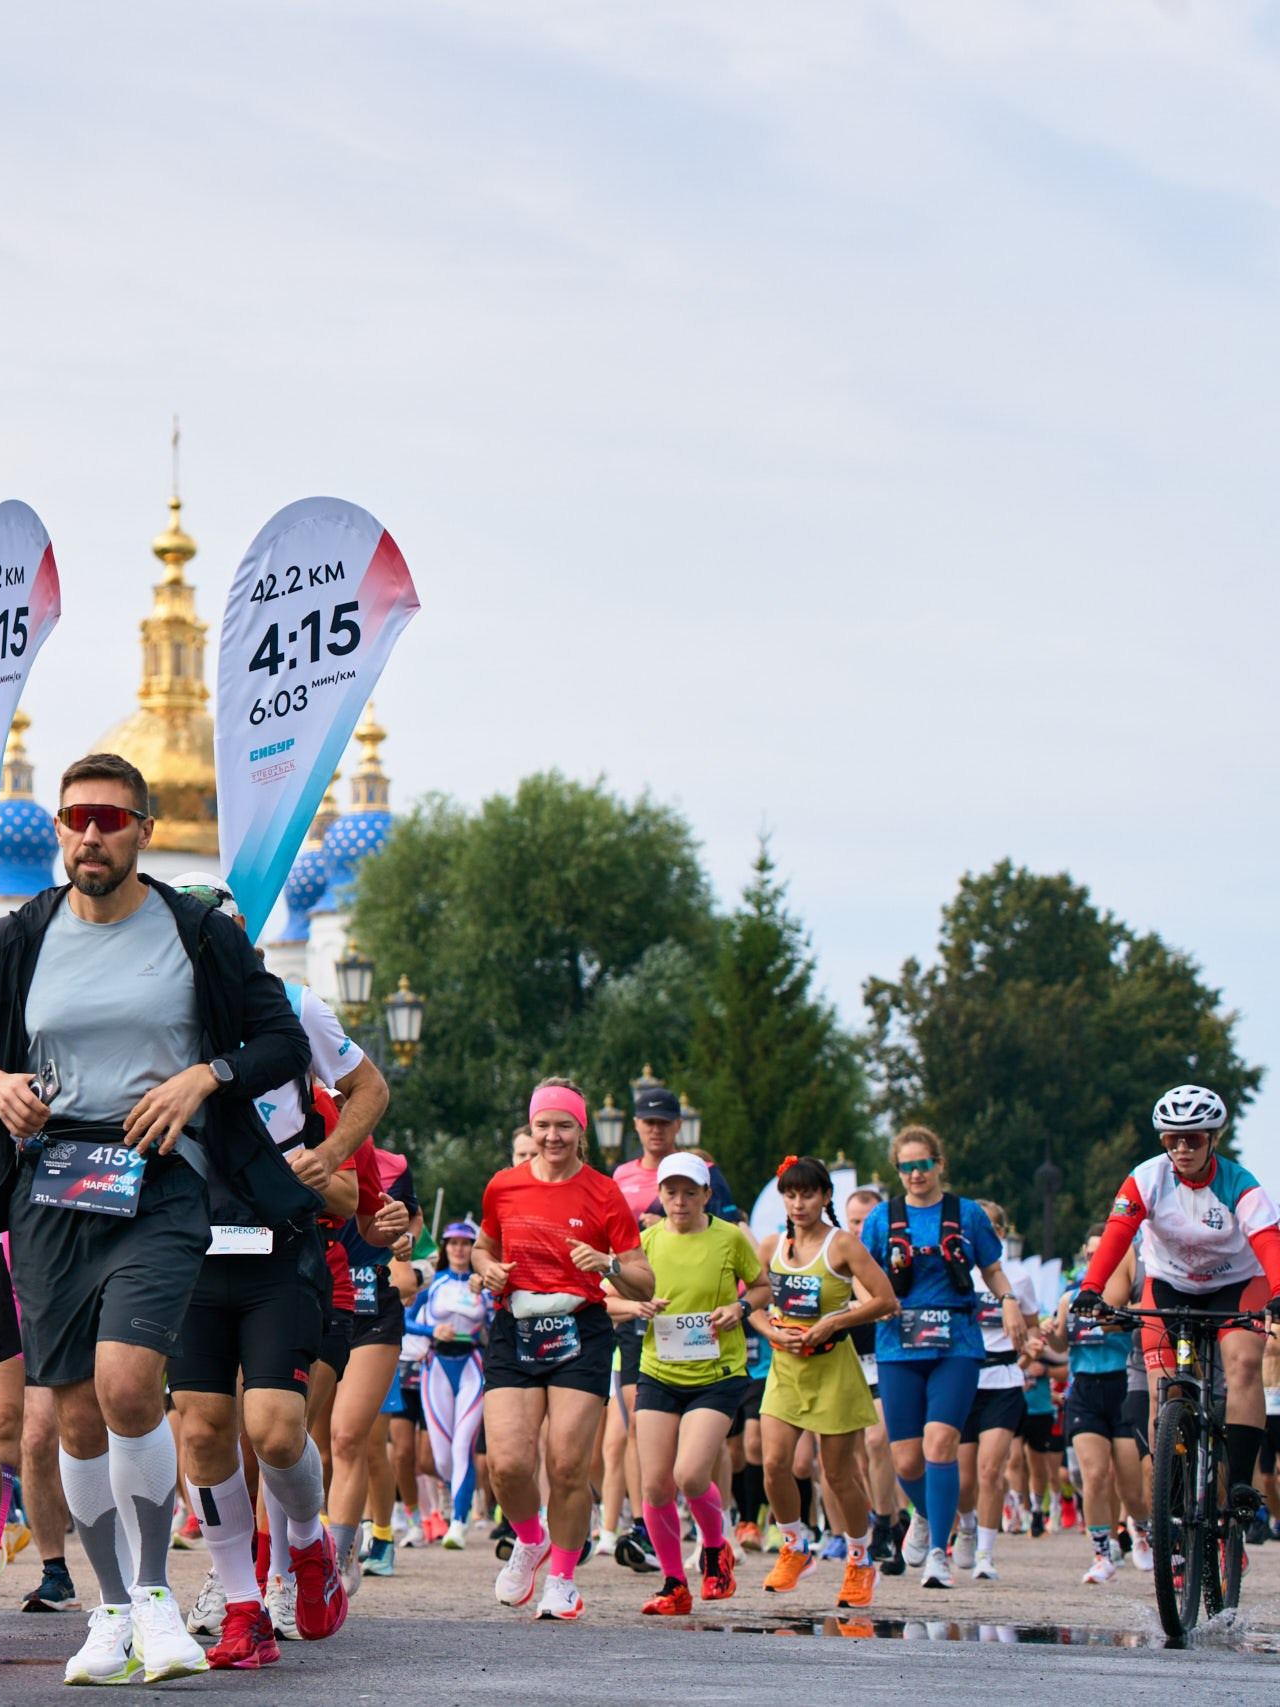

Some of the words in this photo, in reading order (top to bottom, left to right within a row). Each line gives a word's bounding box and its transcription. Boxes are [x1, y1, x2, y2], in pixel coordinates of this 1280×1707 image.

[5, 566, 25, 586] КМ
[250, 565, 303, 604] 42.2
[308, 560, 345, 587] КМ
[248, 600, 361, 676] 4:15
[249, 684, 308, 725] 6:03
[311, 670, 356, 688] мин/км
[249, 737, 295, 762] СИБУР
[87, 1146, 142, 1168] 4159
[108, 1173, 138, 1185] #ИДУ
[82, 1180, 135, 1196] НАРЕКОРД
[35, 1193, 49, 1203] 21,1
[220, 1226, 268, 1236] НАРЕКОРД
[349, 1267, 375, 1283] 146
[785, 1275, 818, 1290] 4552
[676, 1314, 712, 1330] 5039
[920, 1309, 950, 1323] 4210
[534, 1316, 573, 1333] 4054
